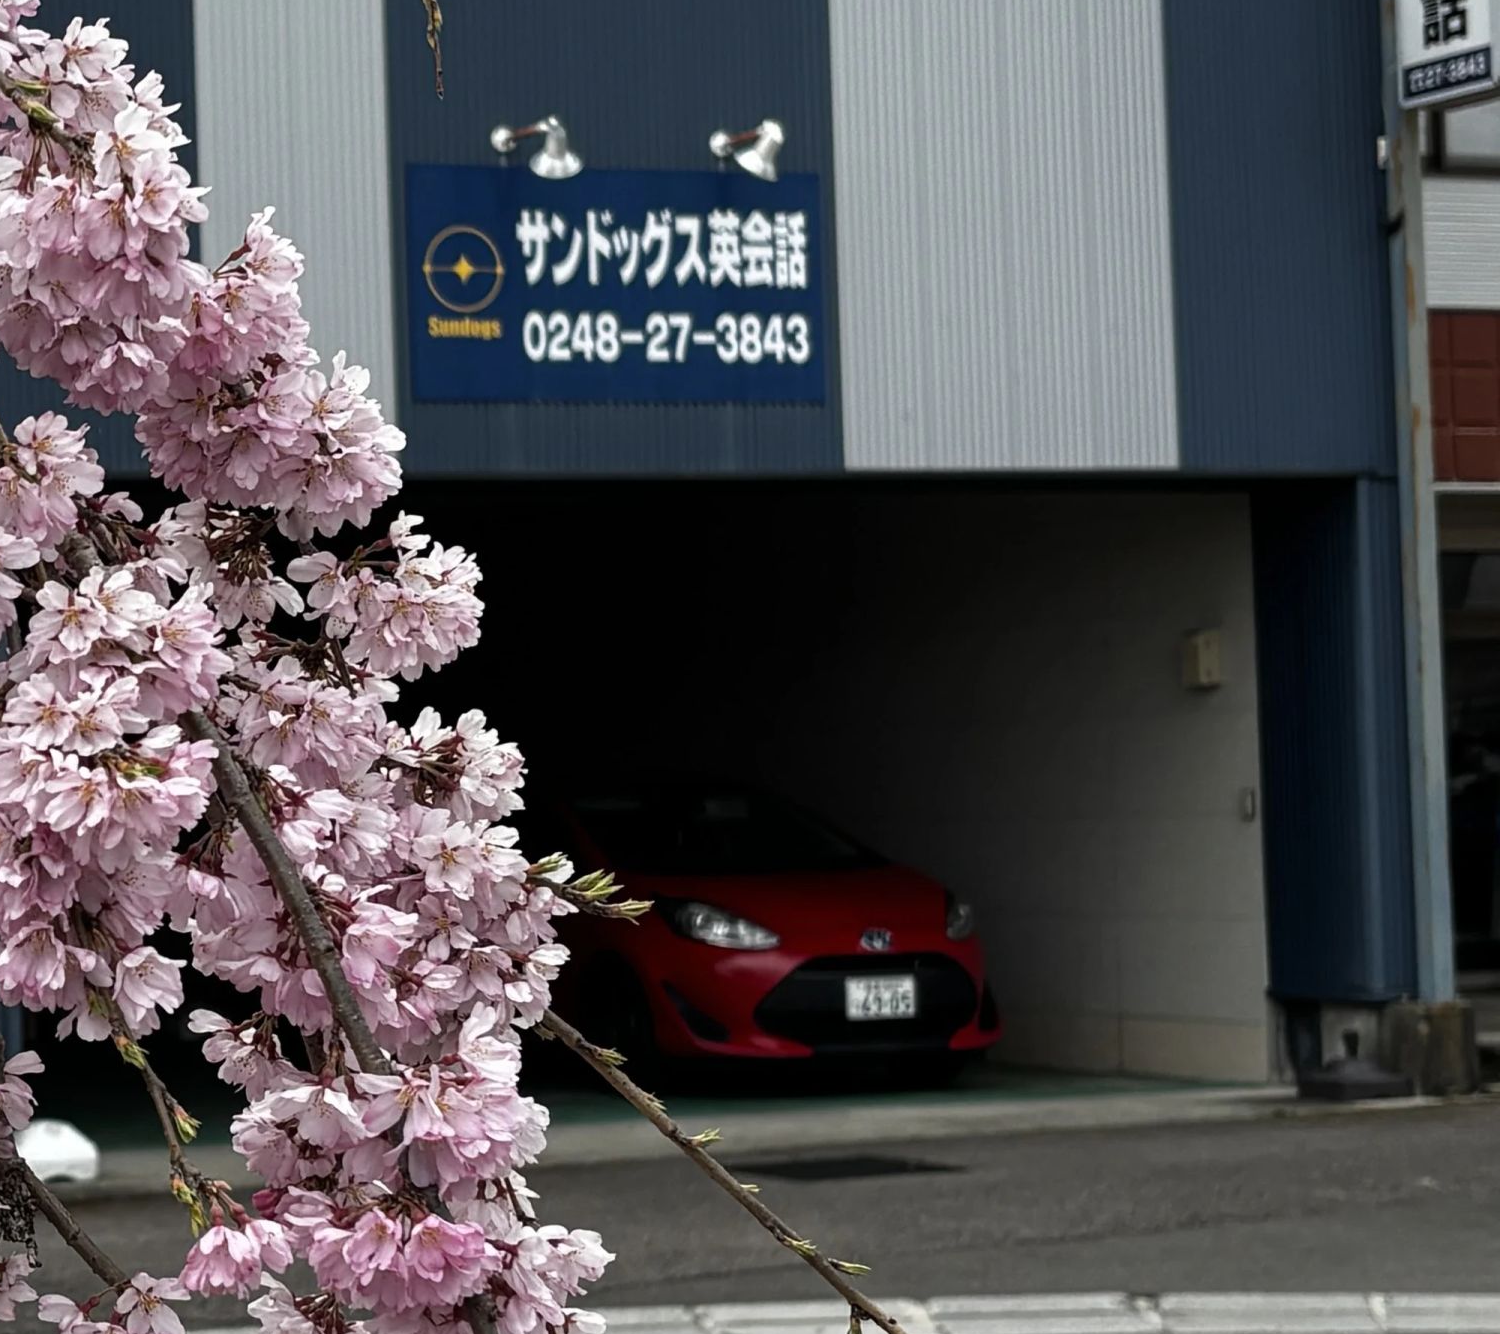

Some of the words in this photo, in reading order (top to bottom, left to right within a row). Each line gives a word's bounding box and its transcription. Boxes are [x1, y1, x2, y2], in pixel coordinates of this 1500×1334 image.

[515, 208, 808, 289] サンドッグス英会話
[428, 315, 502, 340] Sundogs
[522, 310, 810, 365] 0248-27-3843
